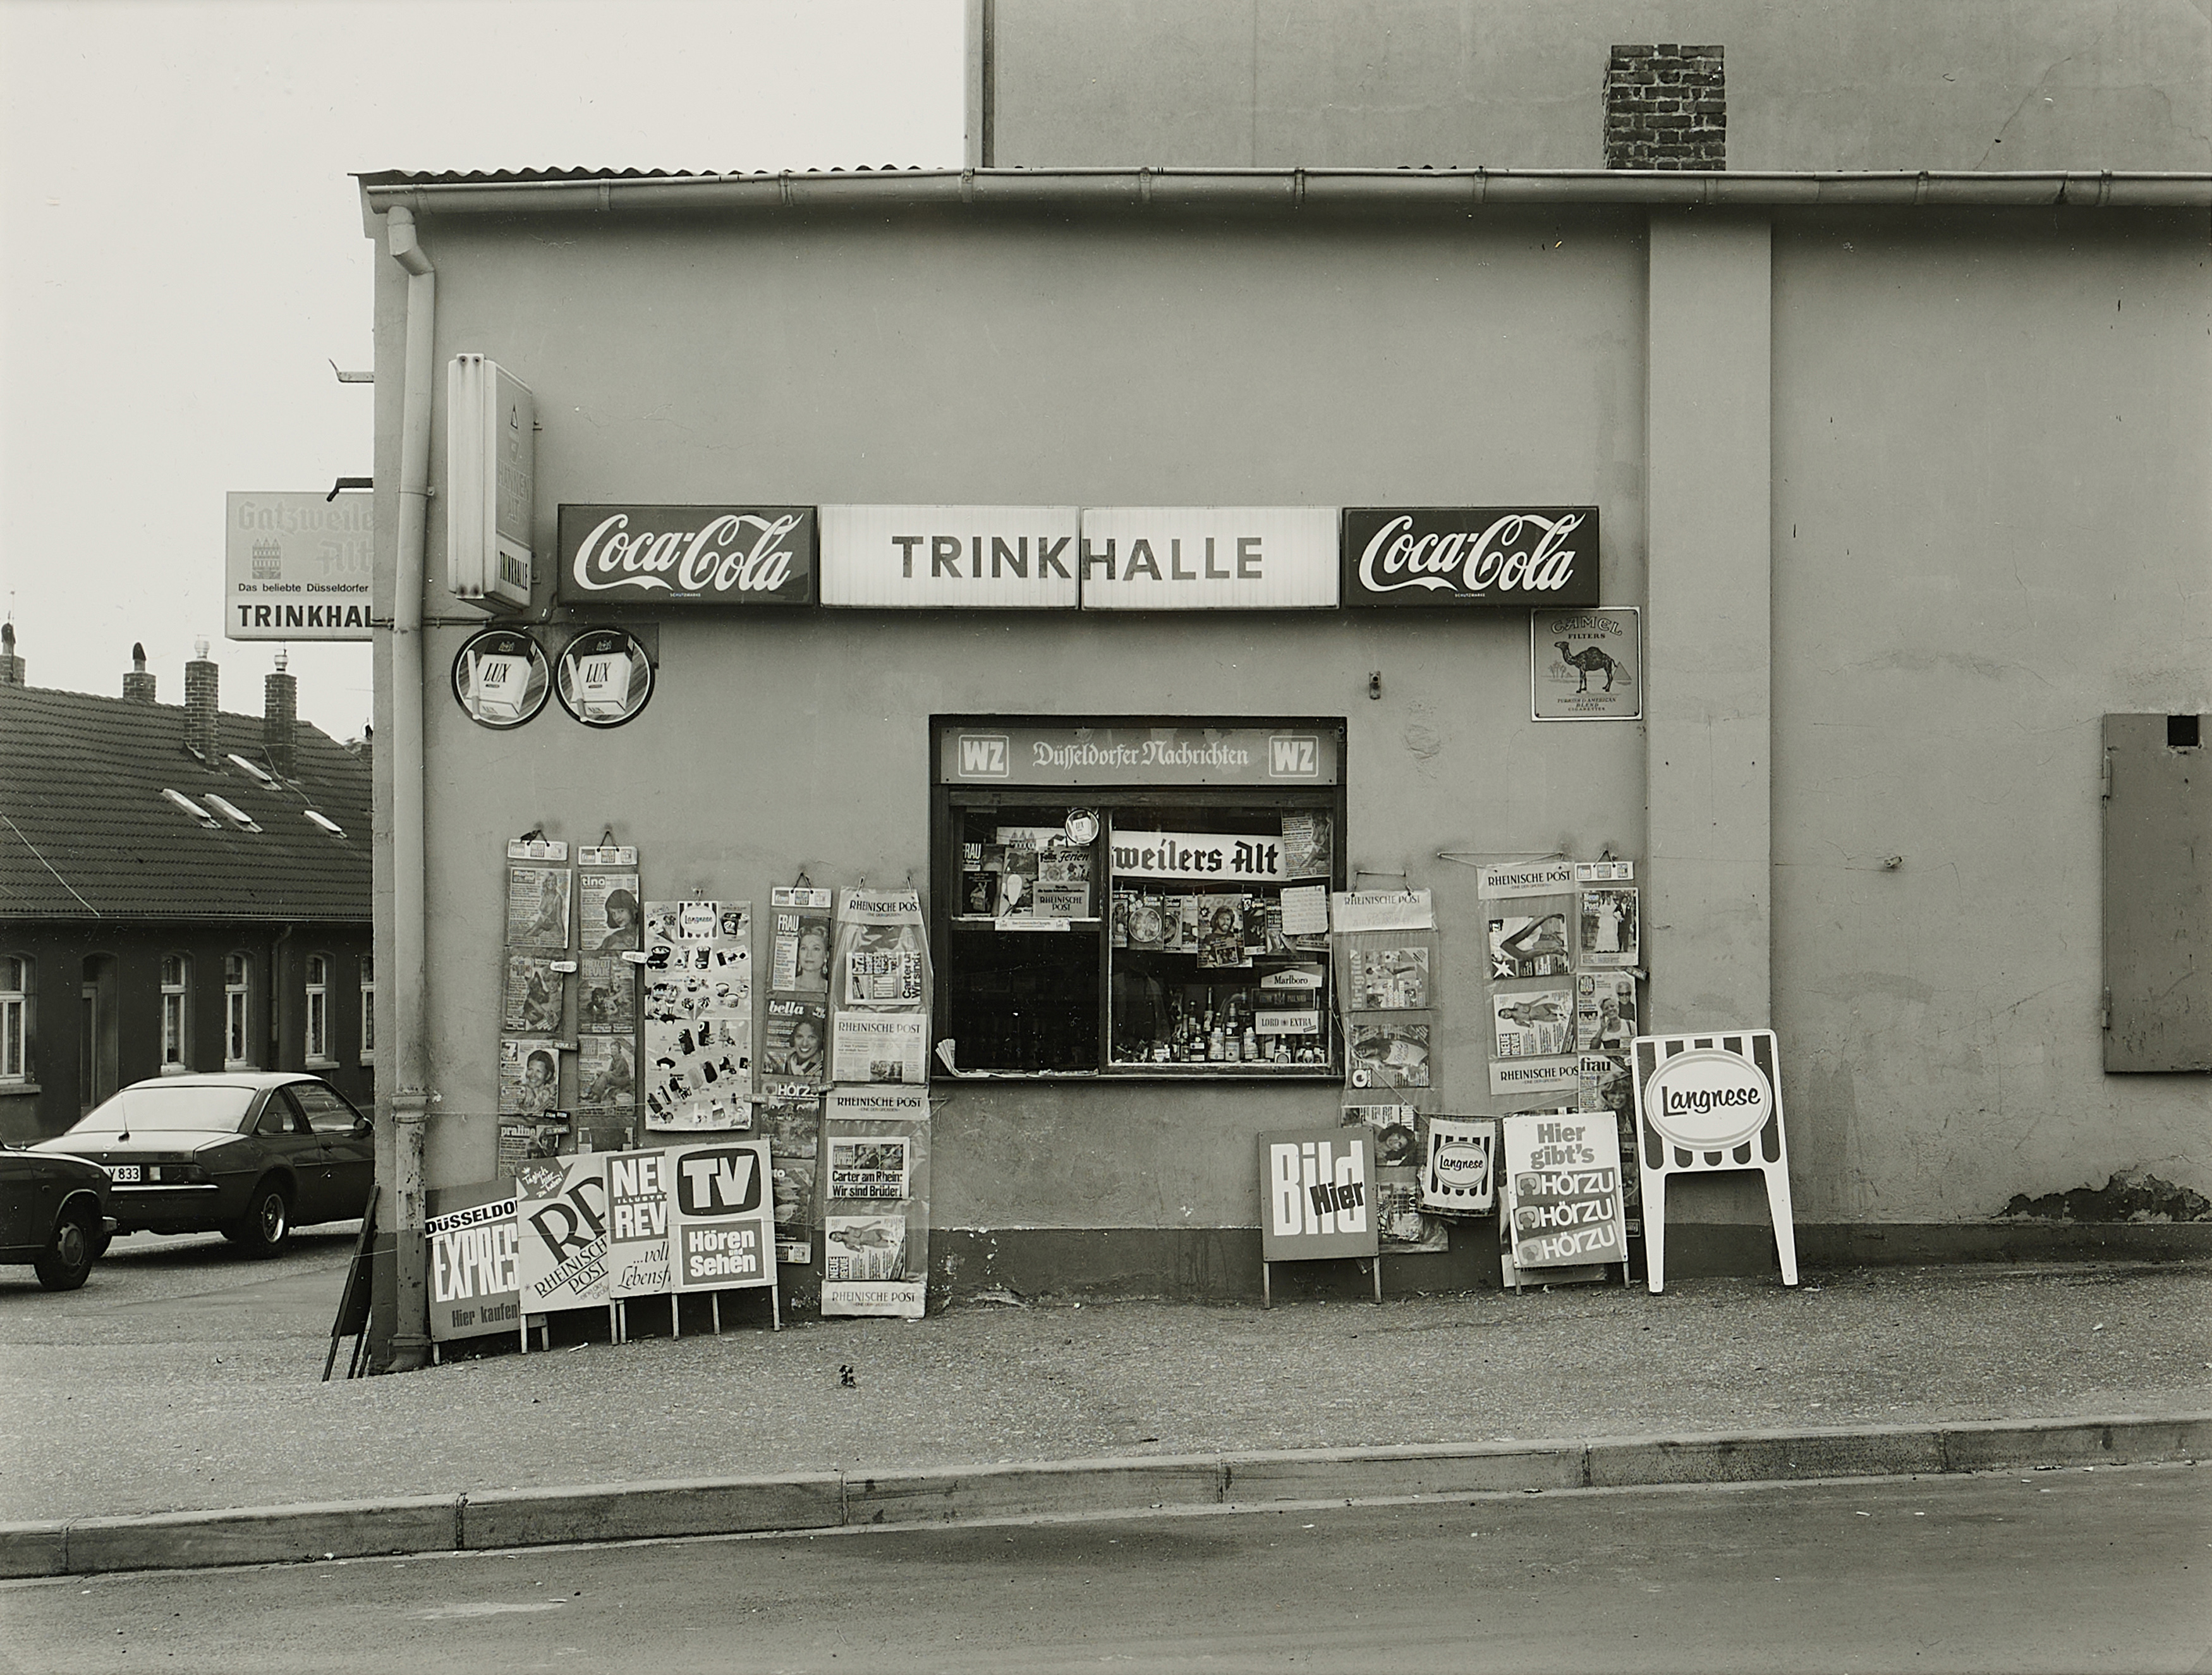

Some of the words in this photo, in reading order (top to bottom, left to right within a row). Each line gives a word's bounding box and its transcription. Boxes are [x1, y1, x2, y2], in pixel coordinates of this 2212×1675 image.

[573, 513, 804, 591] Coca-Cola
[892, 536, 1262, 580] TRINKHALLE
[1359, 513, 1586, 592] Coca-Cola
[238, 583, 257, 592] Das
[262, 583, 301, 592] beliebte
[307, 583, 368, 592] Düsseldorfer
[1551, 616, 1622, 636] CAMEL
[483, 663, 511, 683] LUX
[586, 662, 611, 683] LUX
[963, 741, 1004, 771] WZ
[1141, 740, 1249, 769] Nachrichten
[1273, 741, 1313, 771] WZ
[1059, 850, 1090, 863] Ferien
[1112, 838, 1222, 872] weilers
[1231, 840, 1279, 874] Alt
[1488, 872, 1544, 886] RHEINISCHE
[1547, 870, 1571, 882] POST
[849, 900, 896, 912] RHEINISCHE
[899, 902, 920, 912] POS
[1040, 896, 1082, 904] RHEINISCHE
[1052, 903, 1071, 911] POST
[1345, 895, 1396, 905] RHEINISCHE
[1399, 895, 1420, 904] POST
[778, 915, 799, 931] FRAU
[873, 977, 894, 997] Bild
[902, 965, 911, 999] Carter
[1274, 975, 1308, 984] Marlboro
[769, 1001, 804, 1015] bella
[838, 1021, 894, 1033] RHEINISCHE
[897, 1024, 921, 1033] POST
[1261, 1018, 1279, 1026] LORD
[1290, 1018, 1311, 1026] EXTRA
[1501, 1033, 1510, 1056] NEUE
[1581, 1057, 1610, 1071] frau
[1500, 1068, 1556, 1081] RHEINISCHE
[778, 1081, 819, 1097] HÖRZ
[837, 1097, 894, 1107] RHEINISCHE
[897, 1097, 921, 1107] POST
[1661, 1086, 1761, 1117] Langnese
[501, 1125, 536, 1137] praline
[1537, 1123, 1586, 1143] Hier
[1439, 1154, 1483, 1171] Langnese
[1530, 1143, 1595, 1169] gibt's
[118, 1167, 139, 1179] 833
[683, 1155, 755, 1209] TV
[832, 1171, 860, 1183] Carter
[861, 1173, 875, 1183] am
[876, 1171, 902, 1183] Rhein:
[832, 1185, 848, 1197] Wir
[849, 1185, 868, 1197] sind
[870, 1185, 902, 1197] Brüder!
[1270, 1140, 1366, 1236] Bild
[1310, 1181, 1364, 1216] Hier
[614, 1201, 667, 1239] REV
[689, 1230, 755, 1252] Hören
[432, 1222, 520, 1302] EXPRES
[729, 1248, 743, 1256] und
[690, 1253, 756, 1277] Sehen
[829, 1257, 839, 1279] NEUE
[568, 1260, 605, 1293] POST
[832, 1292, 889, 1301] RHEINISCHE
[891, 1292, 916, 1302] POST
[452, 1310, 475, 1327] Hier
[480, 1301, 520, 1324] kaufen
